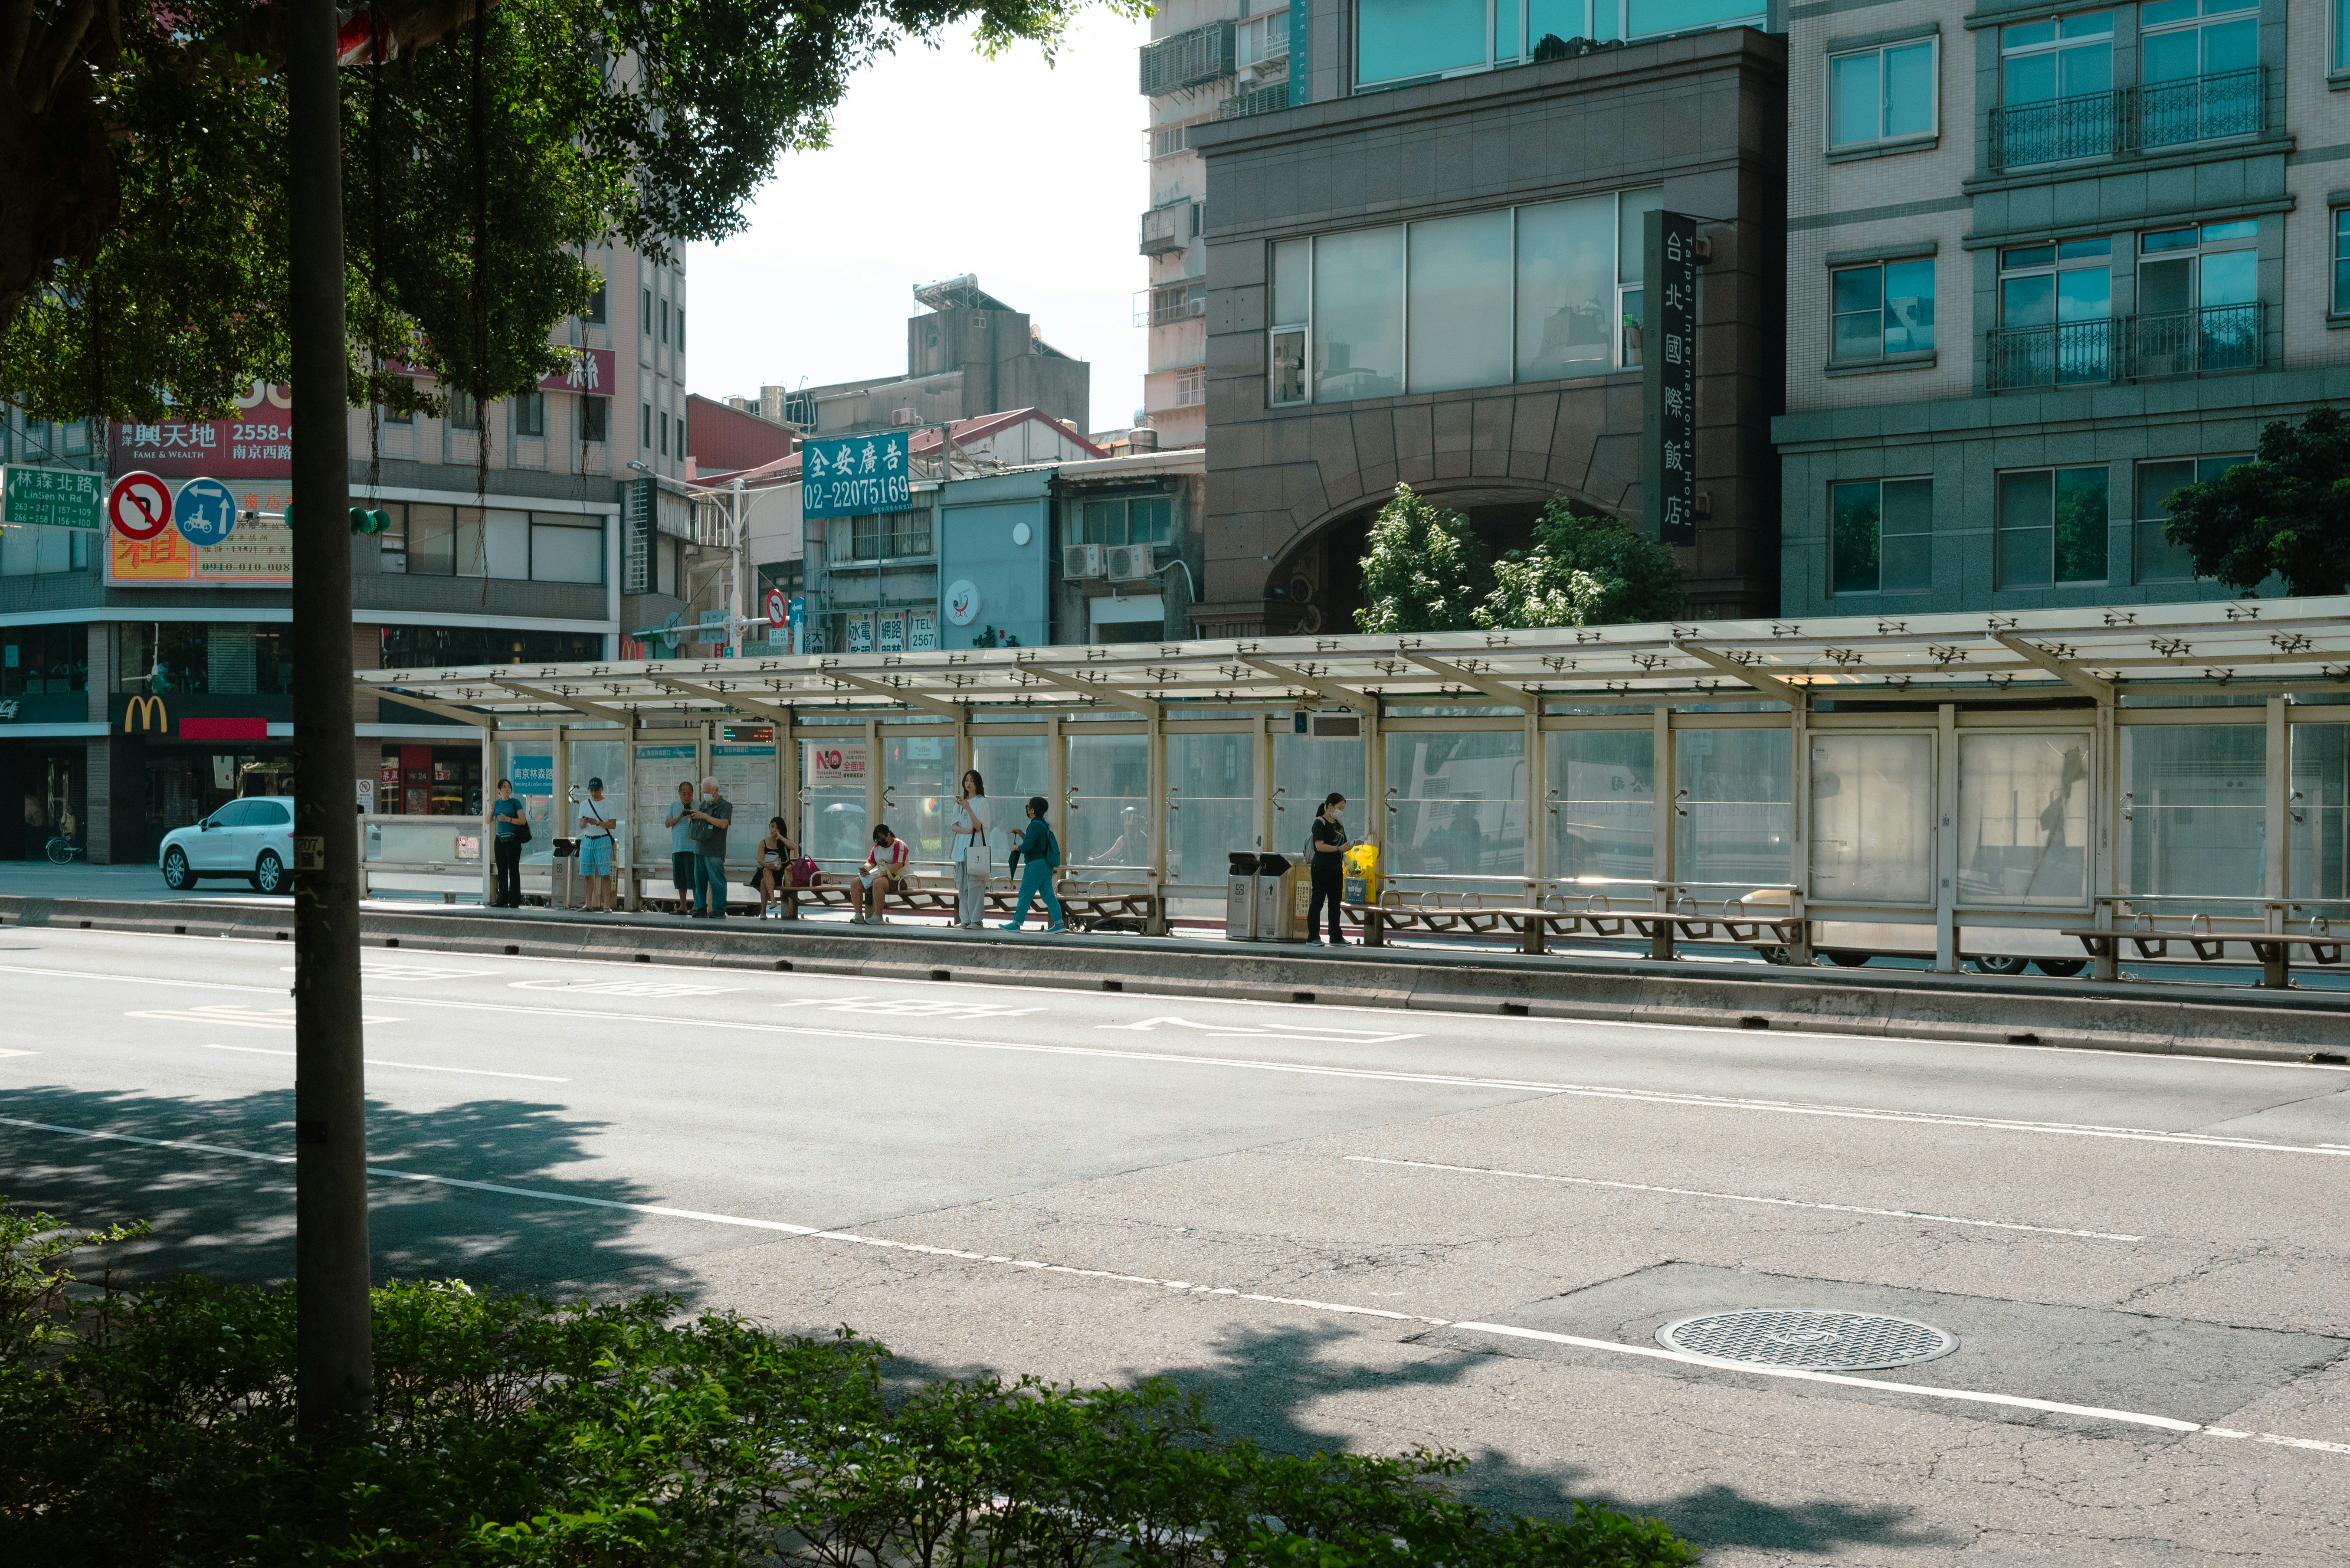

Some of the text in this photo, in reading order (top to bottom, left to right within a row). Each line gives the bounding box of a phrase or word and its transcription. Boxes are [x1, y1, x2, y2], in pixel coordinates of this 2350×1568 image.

[1685, 236, 1693, 301] Taipei
[1665, 231, 1683, 524] 台北國際飯店
[1685, 315, 1693, 457] International
[134, 423, 217, 448] 興天地
[159, 450, 166, 458] &
[232, 444, 292, 460] 南京西路
[808, 439, 902, 478] 全安廣告
[16, 470, 92, 493] 林森北路
[24, 490, 84, 503] LinSen N. Rd.
[804, 475, 909, 510] 02-22075169
[850, 621, 871, 642] 水電
[881, 620, 902, 639] 網路
[914, 619, 932, 630] TEL
[912, 633, 934, 647] 2567
[0, 700, 20, 719] Café
[816, 750, 842, 769] NO
[843, 761, 865, 772] 全面禁
[514, 768, 553, 780] 南京林森路
